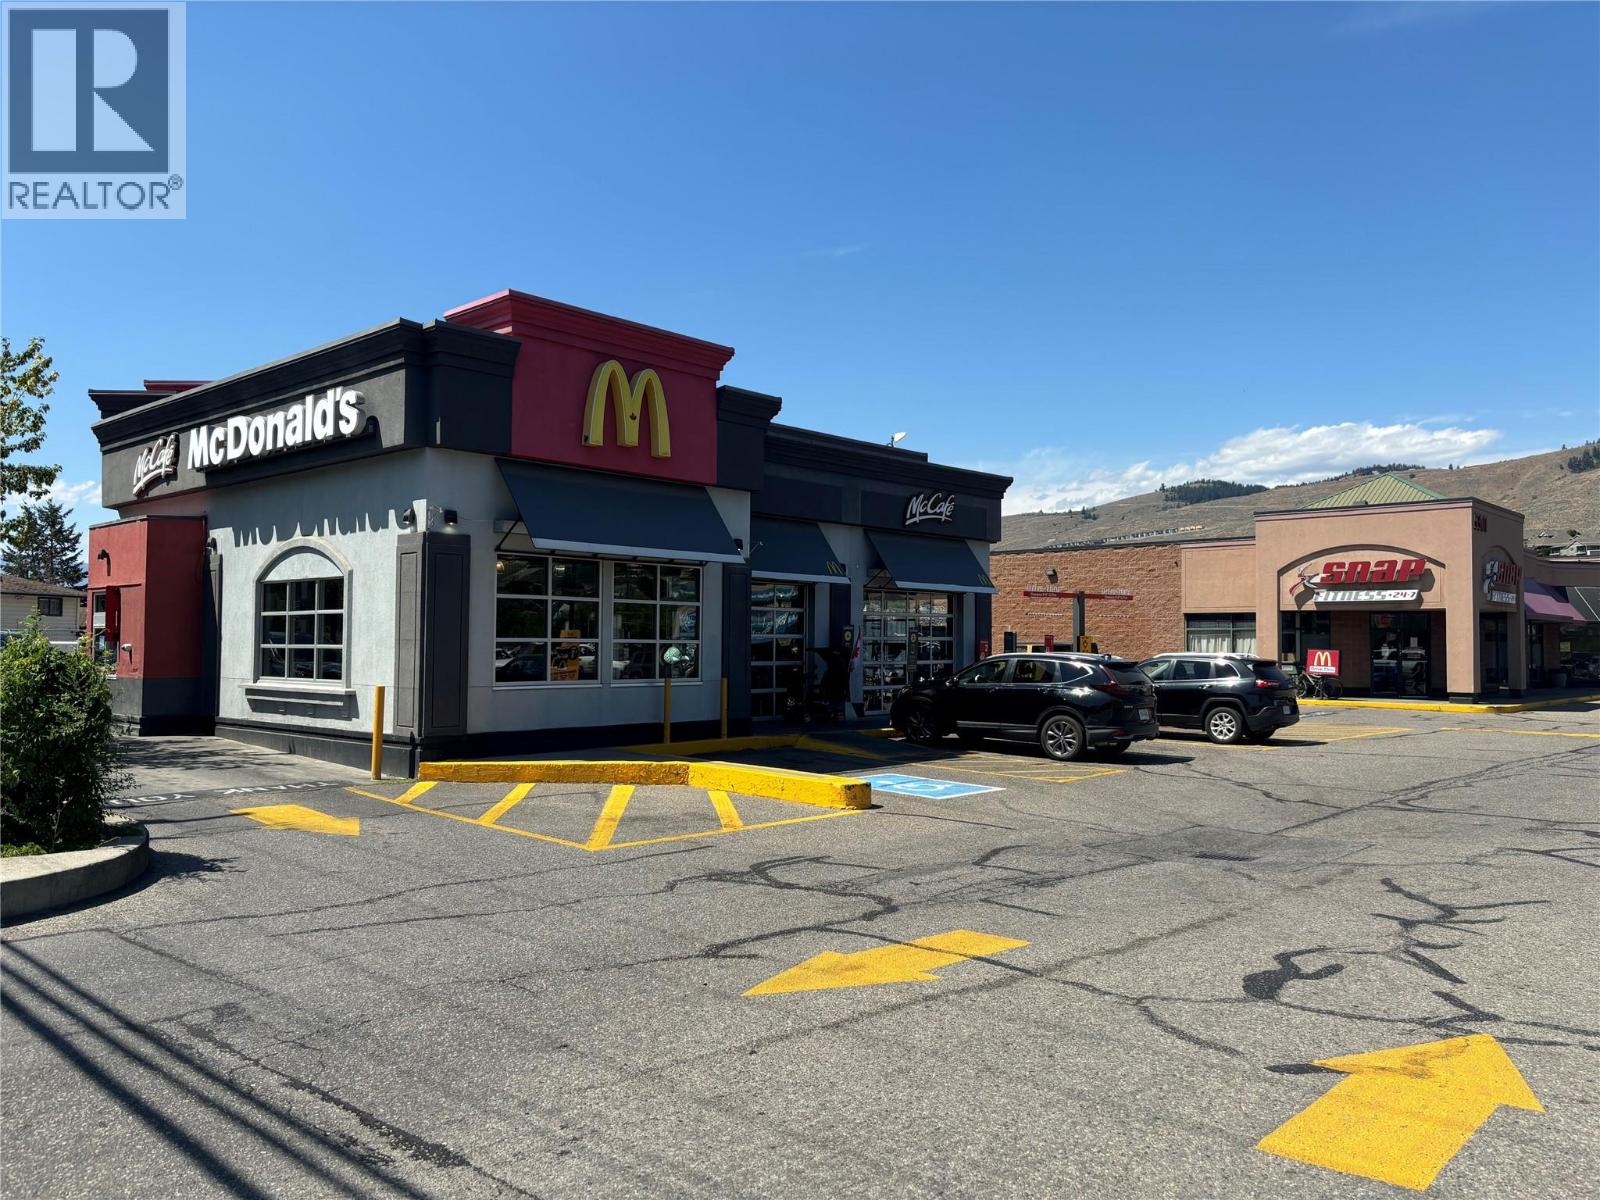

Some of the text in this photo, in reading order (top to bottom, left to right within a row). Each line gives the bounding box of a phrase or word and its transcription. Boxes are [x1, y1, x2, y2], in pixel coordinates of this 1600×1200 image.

[187, 387, 366, 470] McDonald's
[133, 433, 176, 492] McCafé
[905, 493, 955, 524] McCafé
